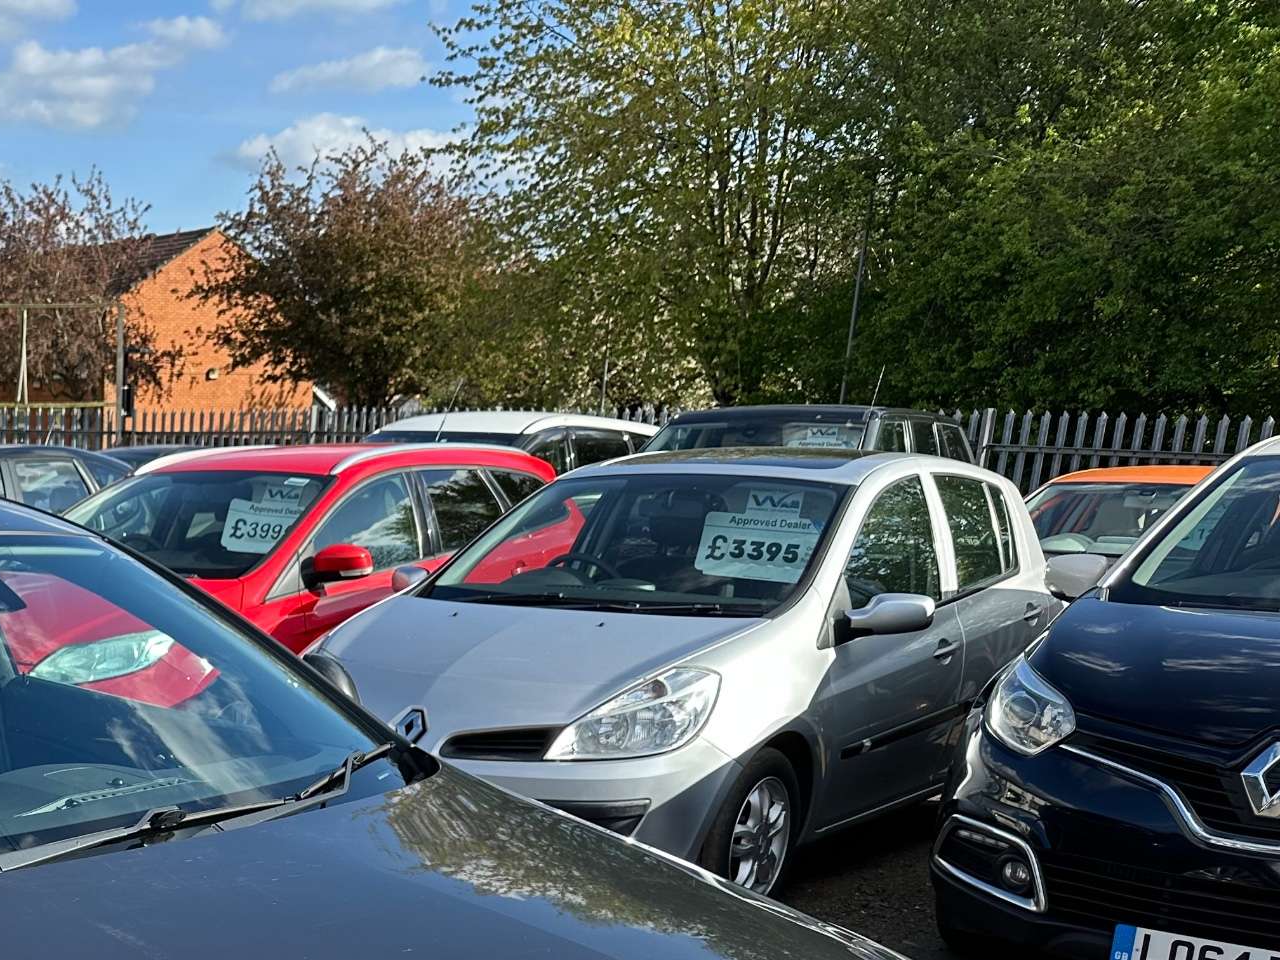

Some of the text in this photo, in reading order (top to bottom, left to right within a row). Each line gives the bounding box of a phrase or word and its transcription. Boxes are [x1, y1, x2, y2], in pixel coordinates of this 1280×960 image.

[249, 503, 283, 515] Approved
[229, 518, 289, 541] £399
[729, 515, 812, 530] Approved Dealer
[705, 534, 801, 563] £3395
